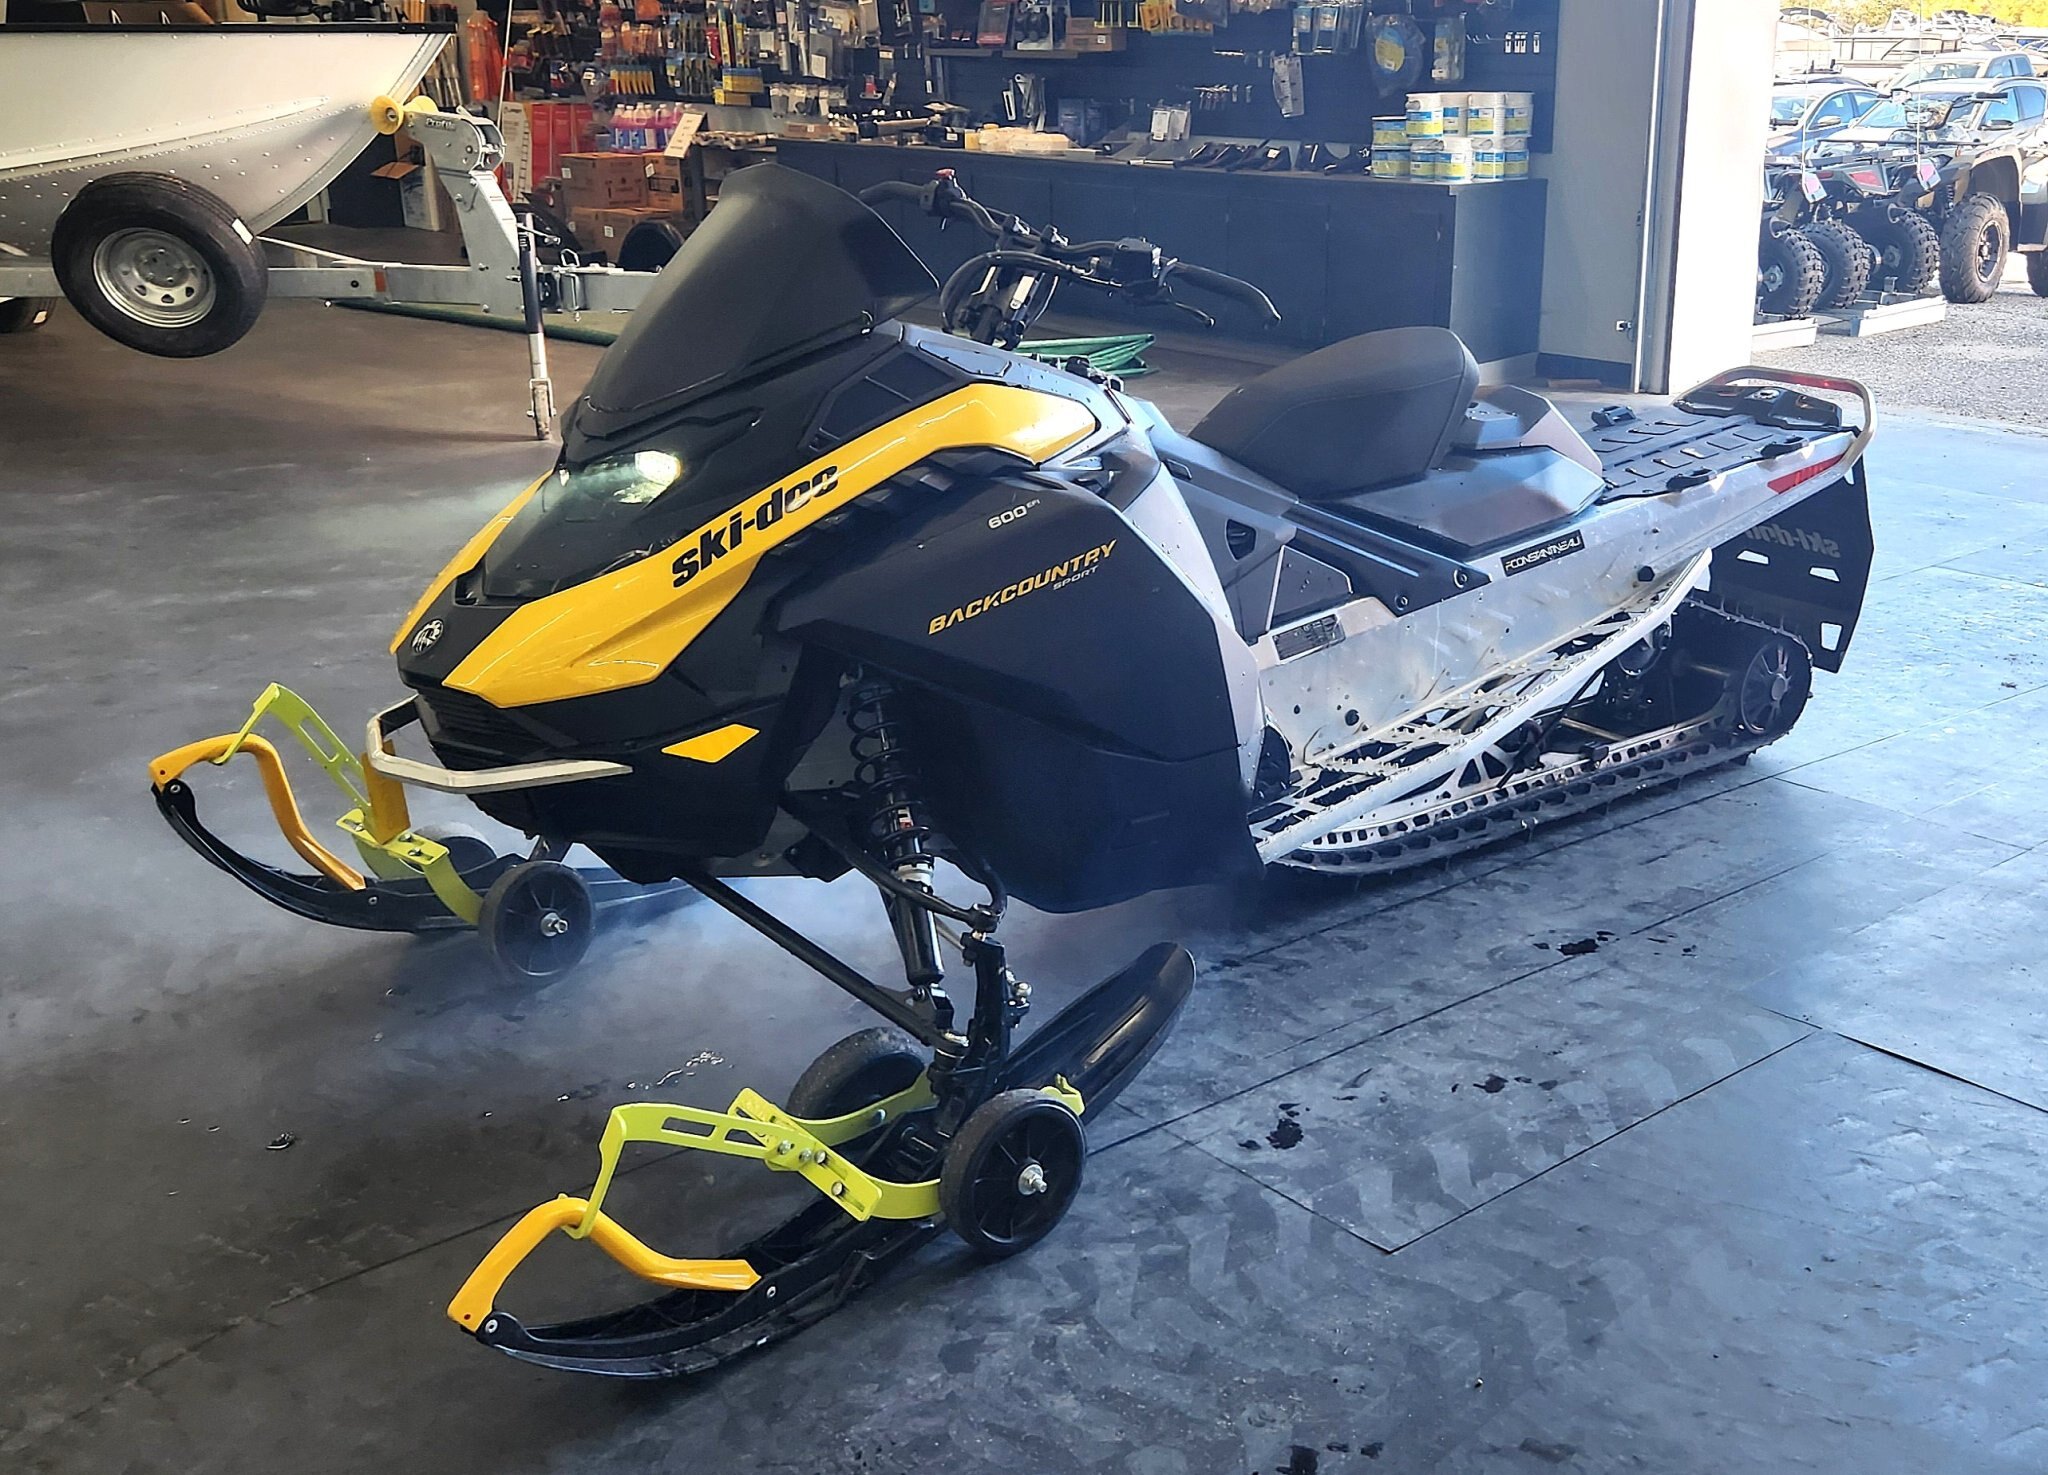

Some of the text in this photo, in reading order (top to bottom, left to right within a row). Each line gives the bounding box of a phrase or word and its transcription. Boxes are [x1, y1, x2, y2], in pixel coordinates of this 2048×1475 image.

[988, 505, 1028, 529] 600
[928, 539, 1117, 635] BACKCOUNTRY
[1053, 565, 1099, 590] SPORT
